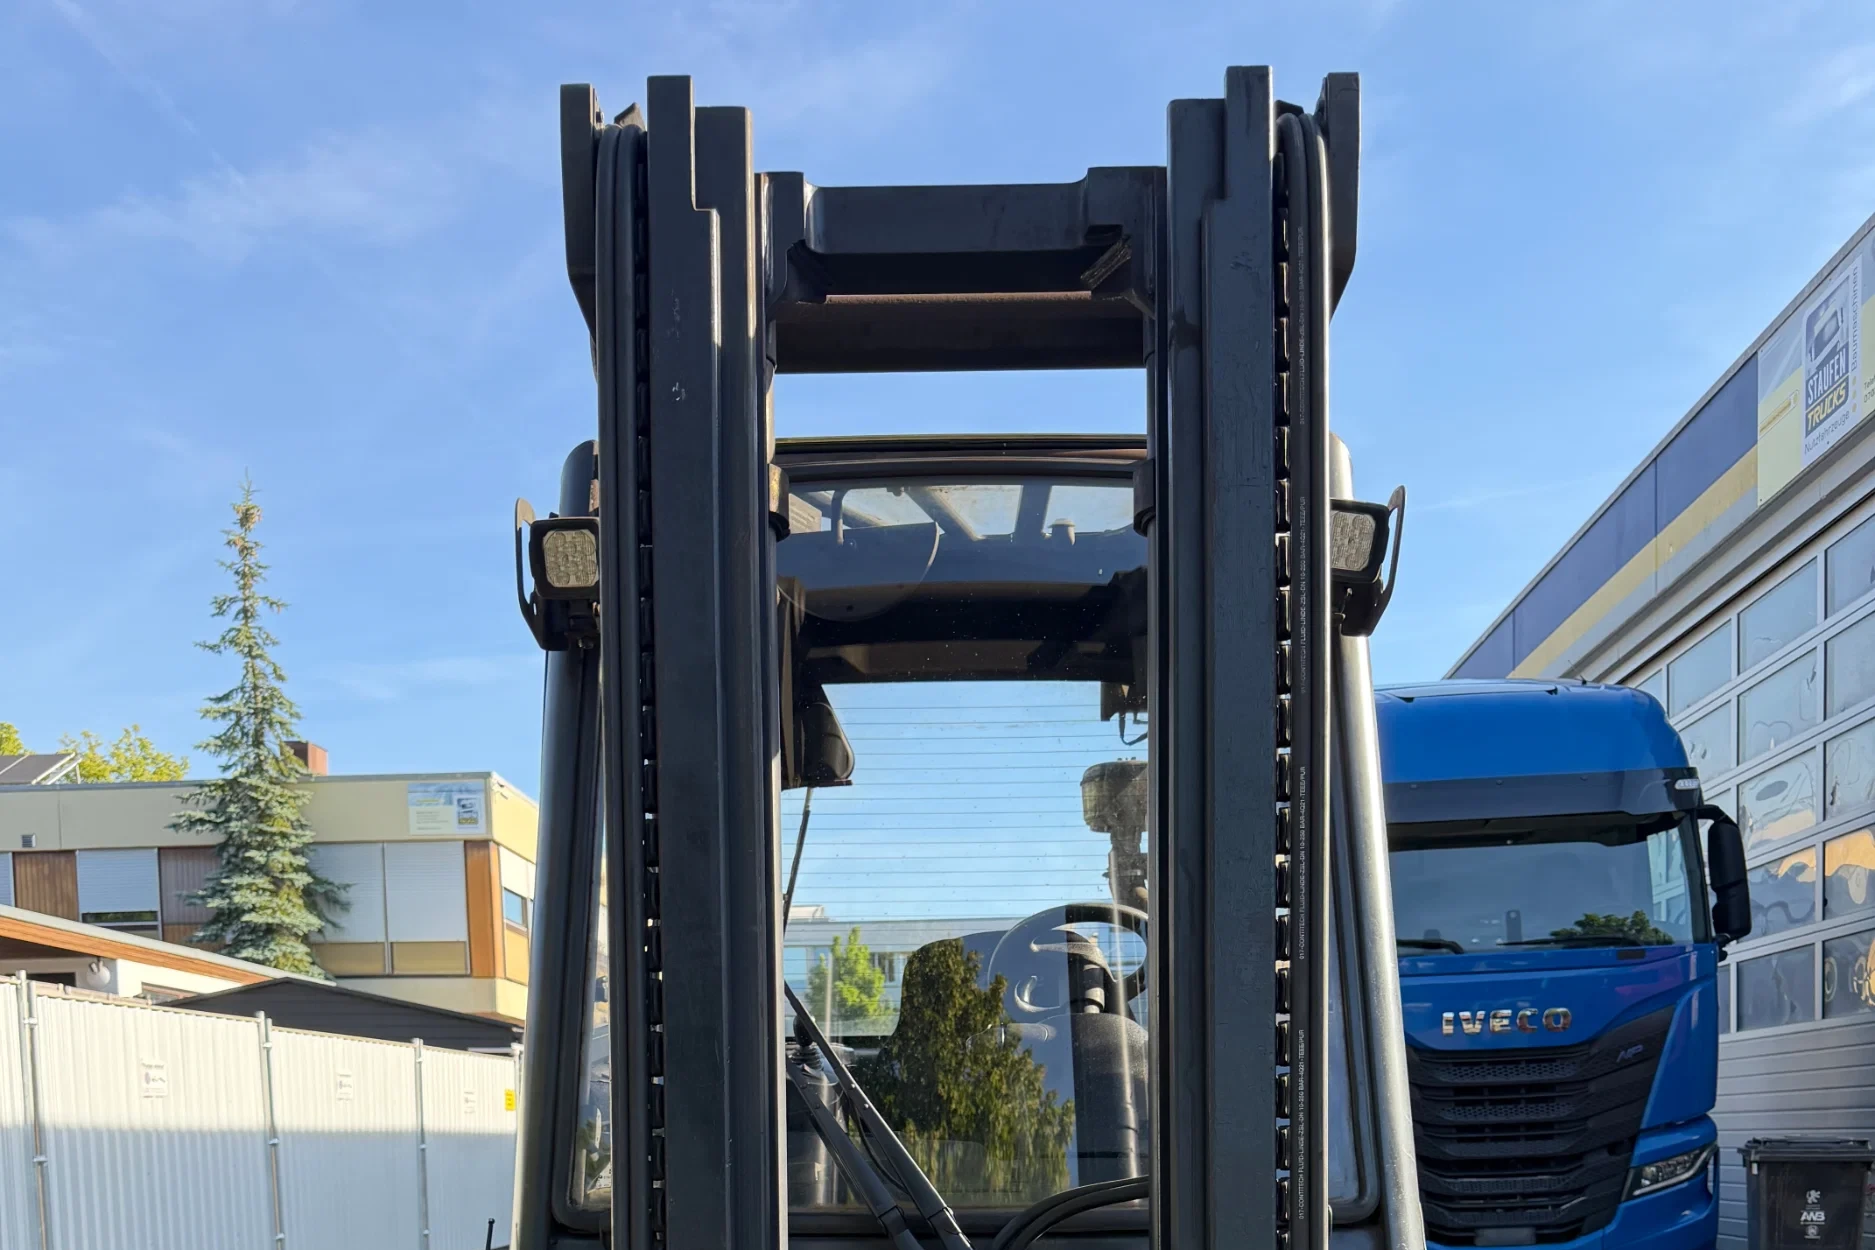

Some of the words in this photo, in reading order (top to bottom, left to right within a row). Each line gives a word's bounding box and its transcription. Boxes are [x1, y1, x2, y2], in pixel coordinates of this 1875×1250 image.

[1807, 347, 1846, 405] STAUFEN
[1807, 382, 1846, 431] TRUCKS
[1804, 410, 1850, 455] Nutzfahrzeuge
[1442, 1007, 1572, 1036] IVECO
